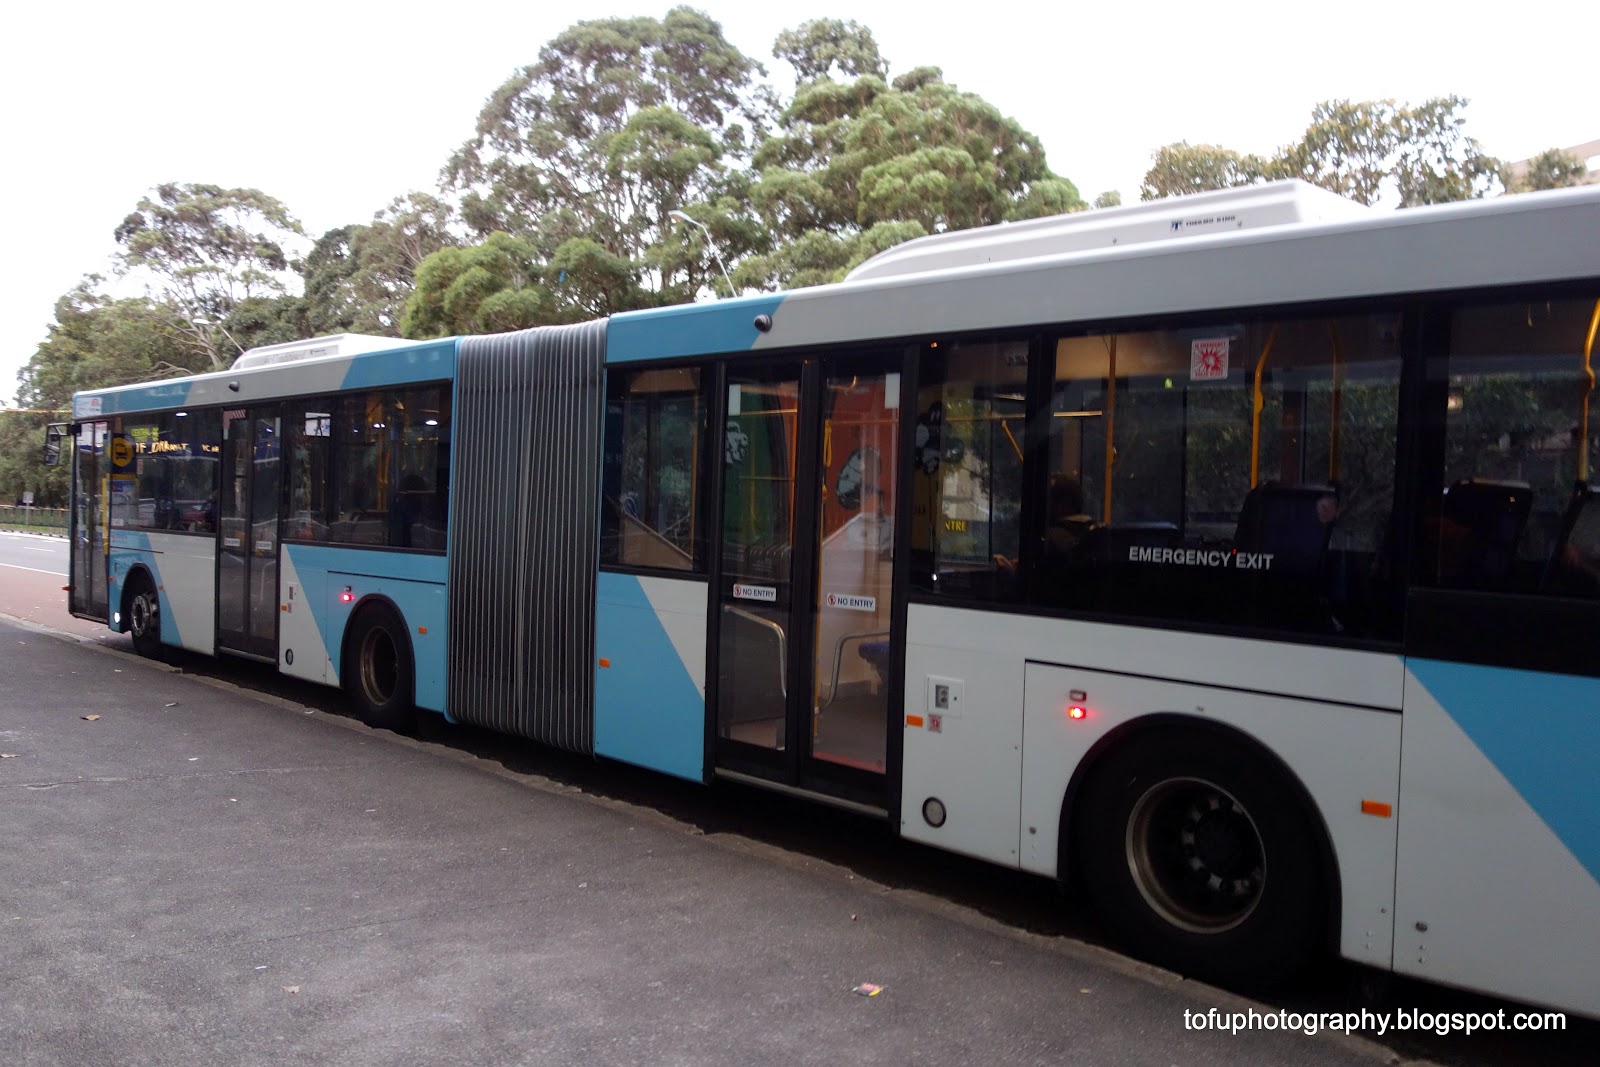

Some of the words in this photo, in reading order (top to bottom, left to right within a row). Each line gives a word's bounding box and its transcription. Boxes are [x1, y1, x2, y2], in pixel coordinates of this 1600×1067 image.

[1128, 546, 1231, 568] EMERGENCY
[1235, 552, 1274, 570] EXIT
[742, 588, 752, 596] NO
[753, 589, 775, 598] ENTRY
[849, 599, 874, 608] ENTRY
